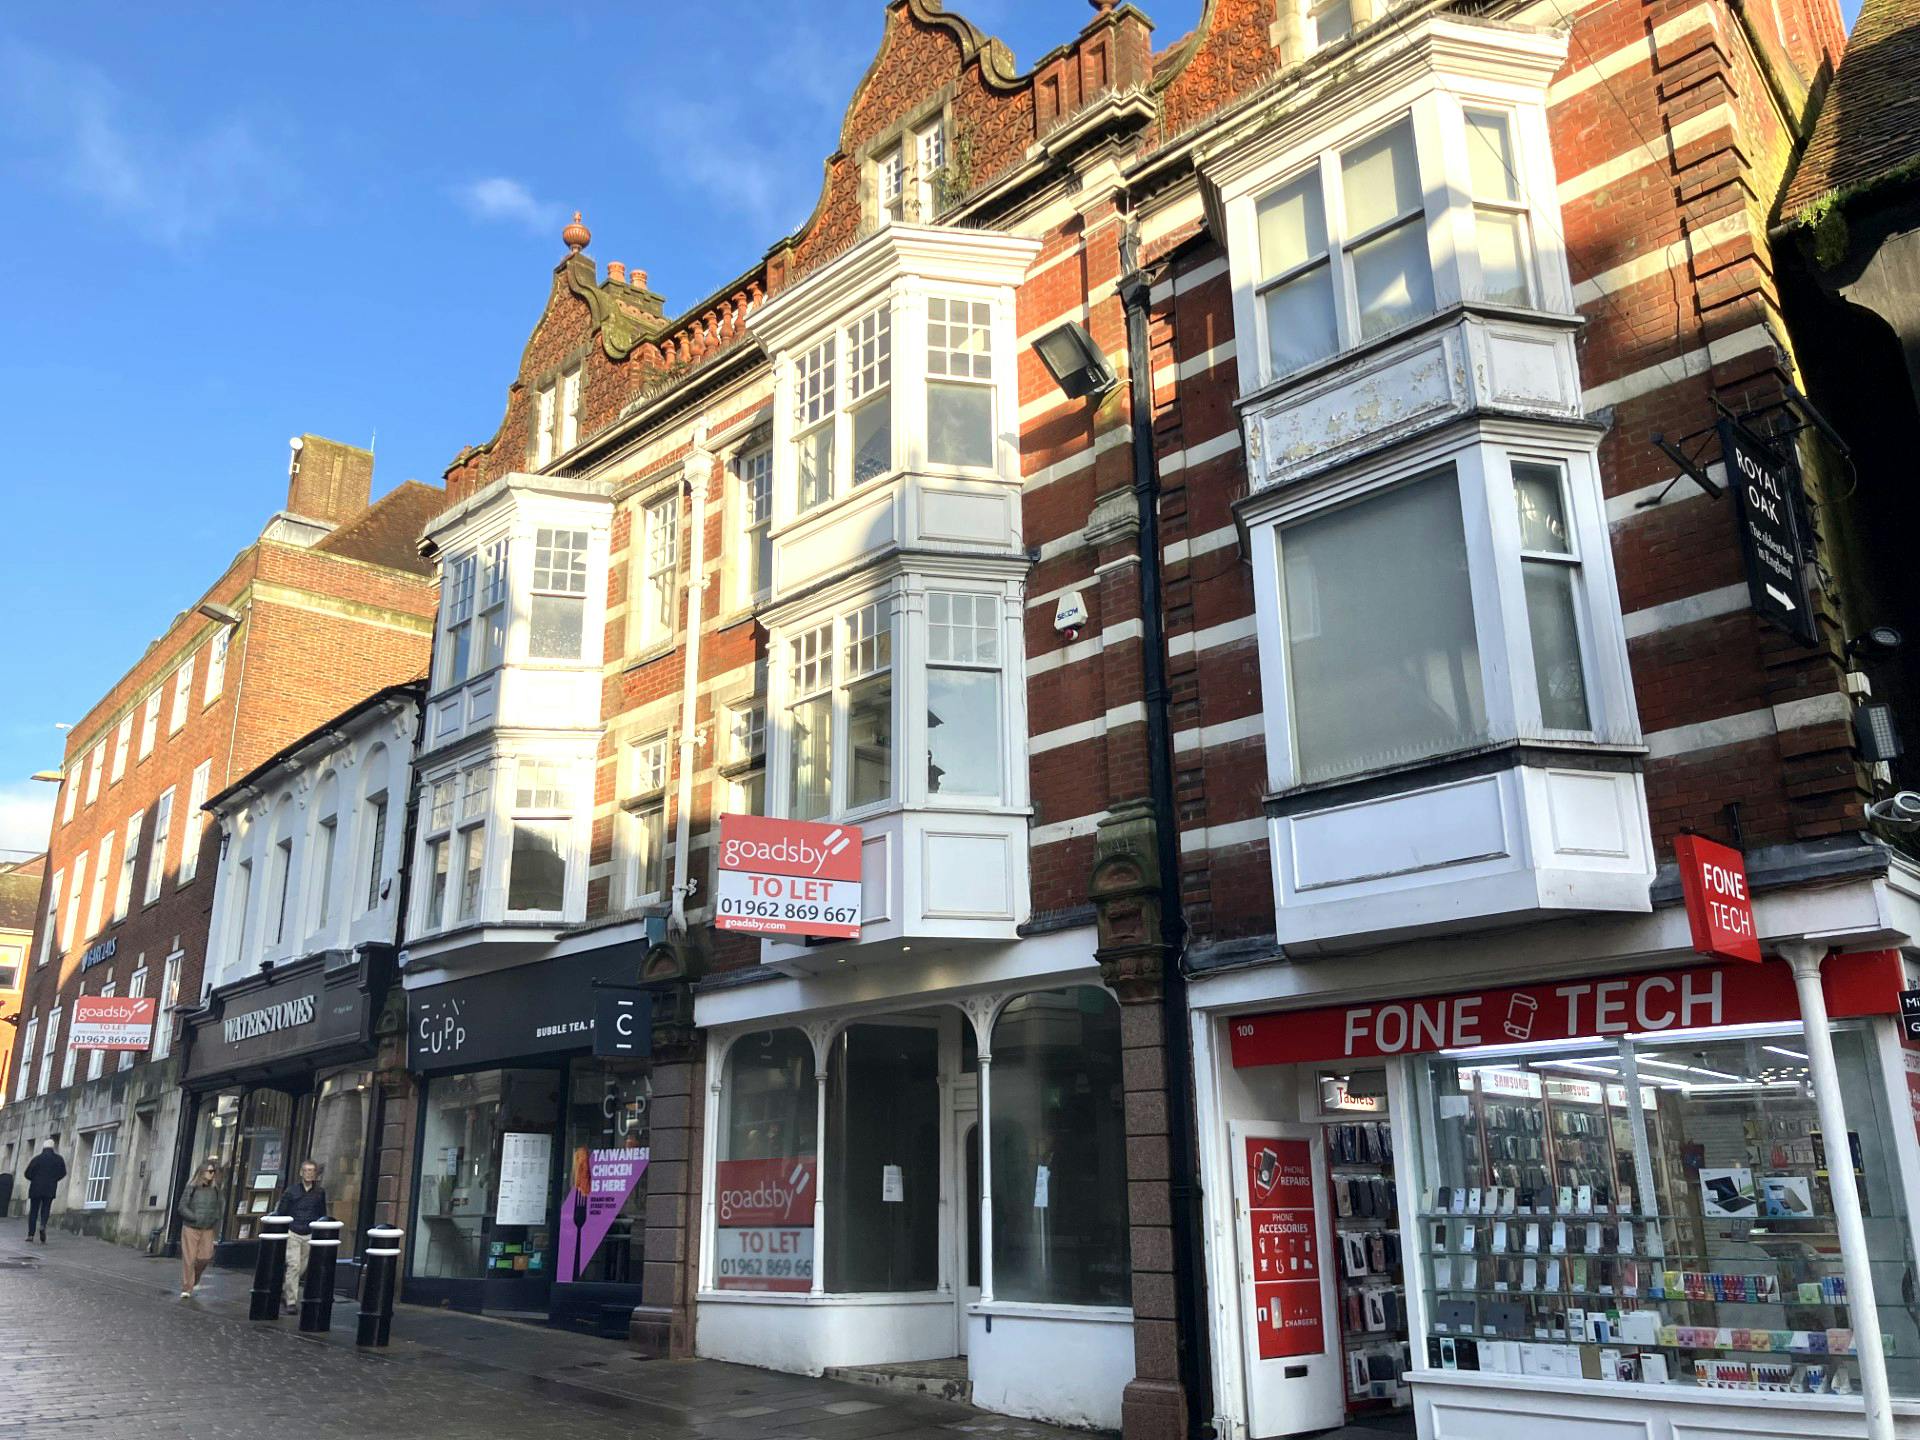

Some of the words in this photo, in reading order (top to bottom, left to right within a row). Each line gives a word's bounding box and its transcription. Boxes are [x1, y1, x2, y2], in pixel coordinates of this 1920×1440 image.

[1735, 447, 1782, 500] ROYAL
[1748, 485, 1780, 525] OAK
[1057, 607, 1079, 621] SECOM
[724, 836, 829, 875] goadsby
[748, 875, 783, 898] TO
[789, 879, 833, 902] LET
[1703, 862, 1745, 900] FONE
[721, 897, 779, 918] 01962
[784, 903, 819, 921] 869
[823, 906, 857, 923] 667
[1709, 901, 1751, 936] TECH
[724, 918, 786, 931] goadsby.com
[1556, 971, 1723, 1037] TECH
[1905, 996, 1920, 1009] Mi
[78, 1006, 136, 1023] goadsby
[224, 994, 315, 1044] WATERSTONES
[616, 1013, 633, 1036] C
[420, 1016, 466, 1054] CUPP
[536, 1024, 567, 1038] BUBBLE
[569, 1021, 588, 1032] TEA.
[1236, 1023, 1254, 1038] 100
[1344, 996, 1483, 1056] FONE
[73, 1034, 106, 1044] 01962
[107, 1036, 127, 1044] 869
[128, 1036, 148, 1044] 667
[1560, 1082, 1591, 1097] SAMSUNG
[592, 1164, 633, 1177] CHICKEN
[1284, 1165, 1304, 1175] PHONE
[591, 1180, 601, 1192] IS
[601, 1179, 626, 1192] HERE
[1280, 1175, 1310, 1187] REPAIRS
[720, 1180, 794, 1220] goadsby
[1272, 1212, 1294, 1222] PHONE
[1258, 1223, 1308, 1235] ACCESSORIES
[738, 1231, 764, 1254] TO
[768, 1231, 801, 1254] LET
[720, 1257, 763, 1275] 01962
[766, 1258, 792, 1276] 869
[795, 1259, 813, 1277] 66
[1284, 1317, 1318, 1328] CHARGERS
